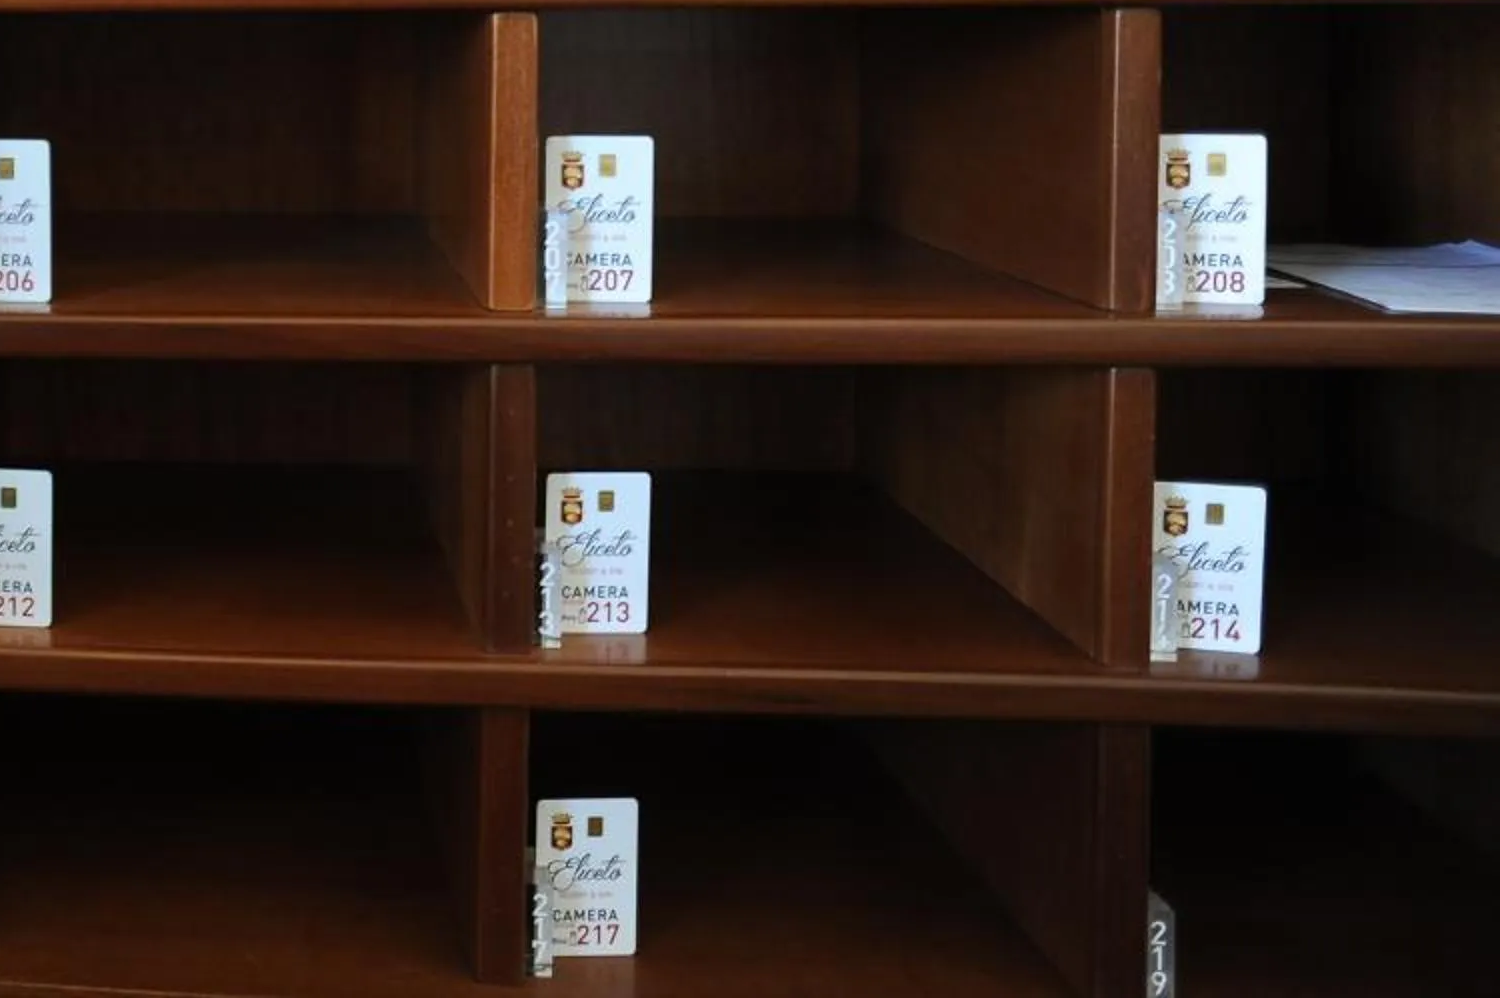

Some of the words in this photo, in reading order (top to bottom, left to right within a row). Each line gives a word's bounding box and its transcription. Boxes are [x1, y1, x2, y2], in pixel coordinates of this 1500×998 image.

[1183, 252, 1244, 267] AMERA
[589, 269, 634, 292] 207
[1195, 270, 1245, 293] 208
[561, 585, 629, 599] CAMERA
[586, 601, 630, 623] 213
[1177, 600, 1241, 616] AMERA
[1190, 617, 1241, 641] 214
[553, 909, 619, 922] CAMERA
[577, 924, 620, 946] 217
[1149, 921, 1167, 995] 219
